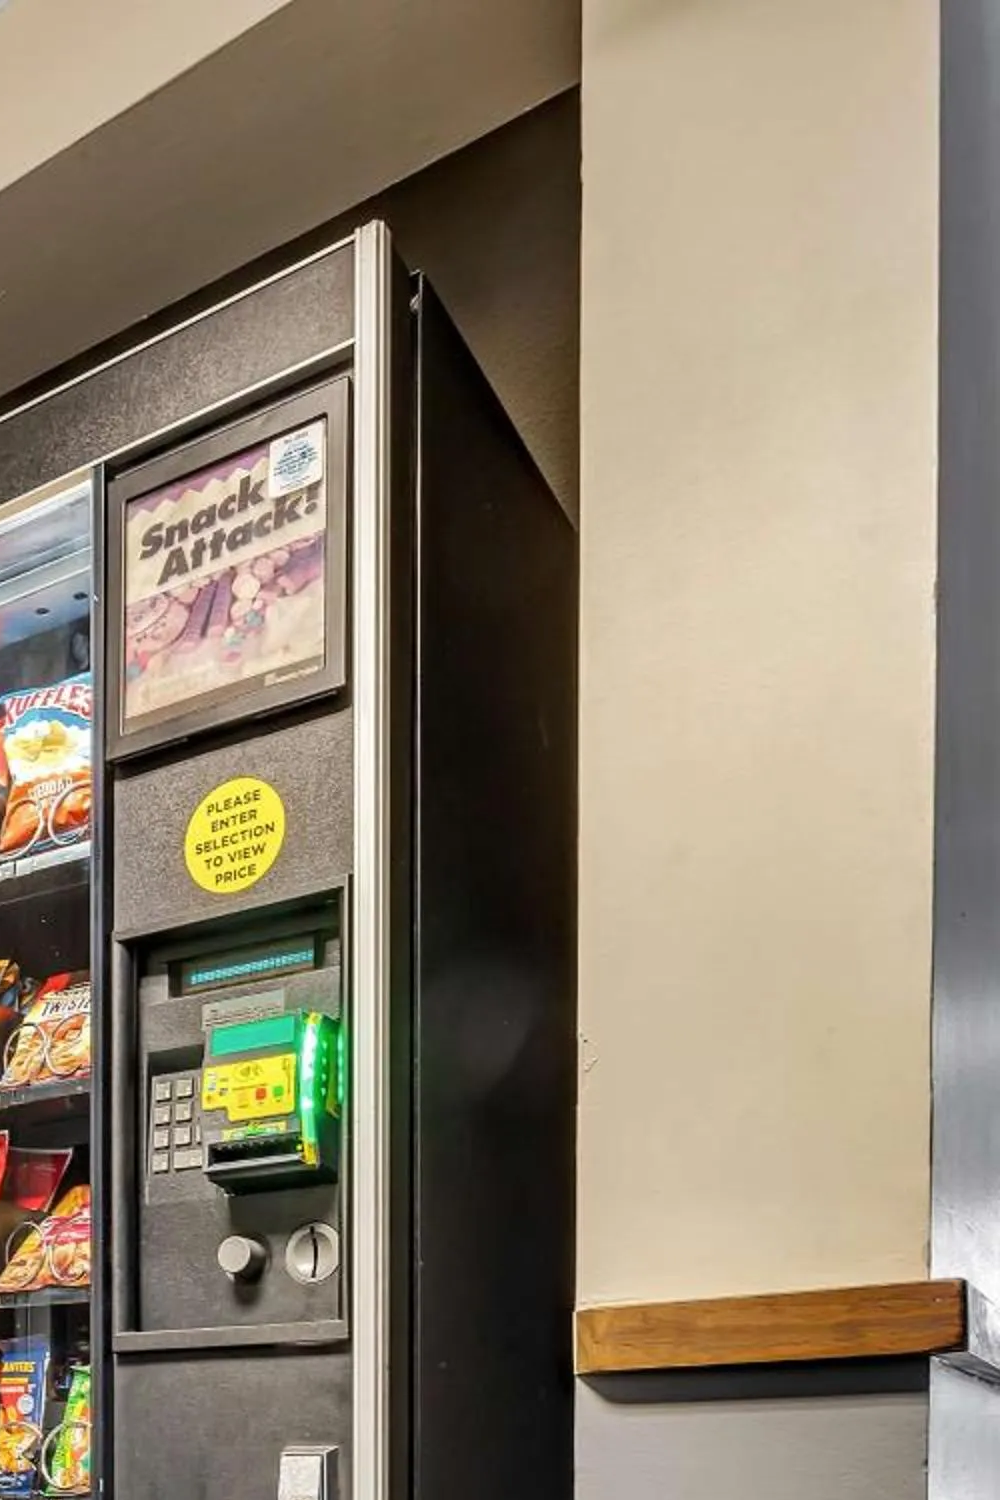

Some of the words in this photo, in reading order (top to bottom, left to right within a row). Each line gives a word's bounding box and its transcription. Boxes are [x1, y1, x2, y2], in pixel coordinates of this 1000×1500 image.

[139, 475, 267, 560] Snack
[157, 482, 323, 586] Attack!
[207, 790, 261, 815] PLEASE
[211, 809, 257, 832] ENTER
[195, 822, 275, 855] SELECTION
[204, 855, 223, 870] TO
[228, 842, 267, 862] VIEW
[215, 863, 257, 885] PRICE
